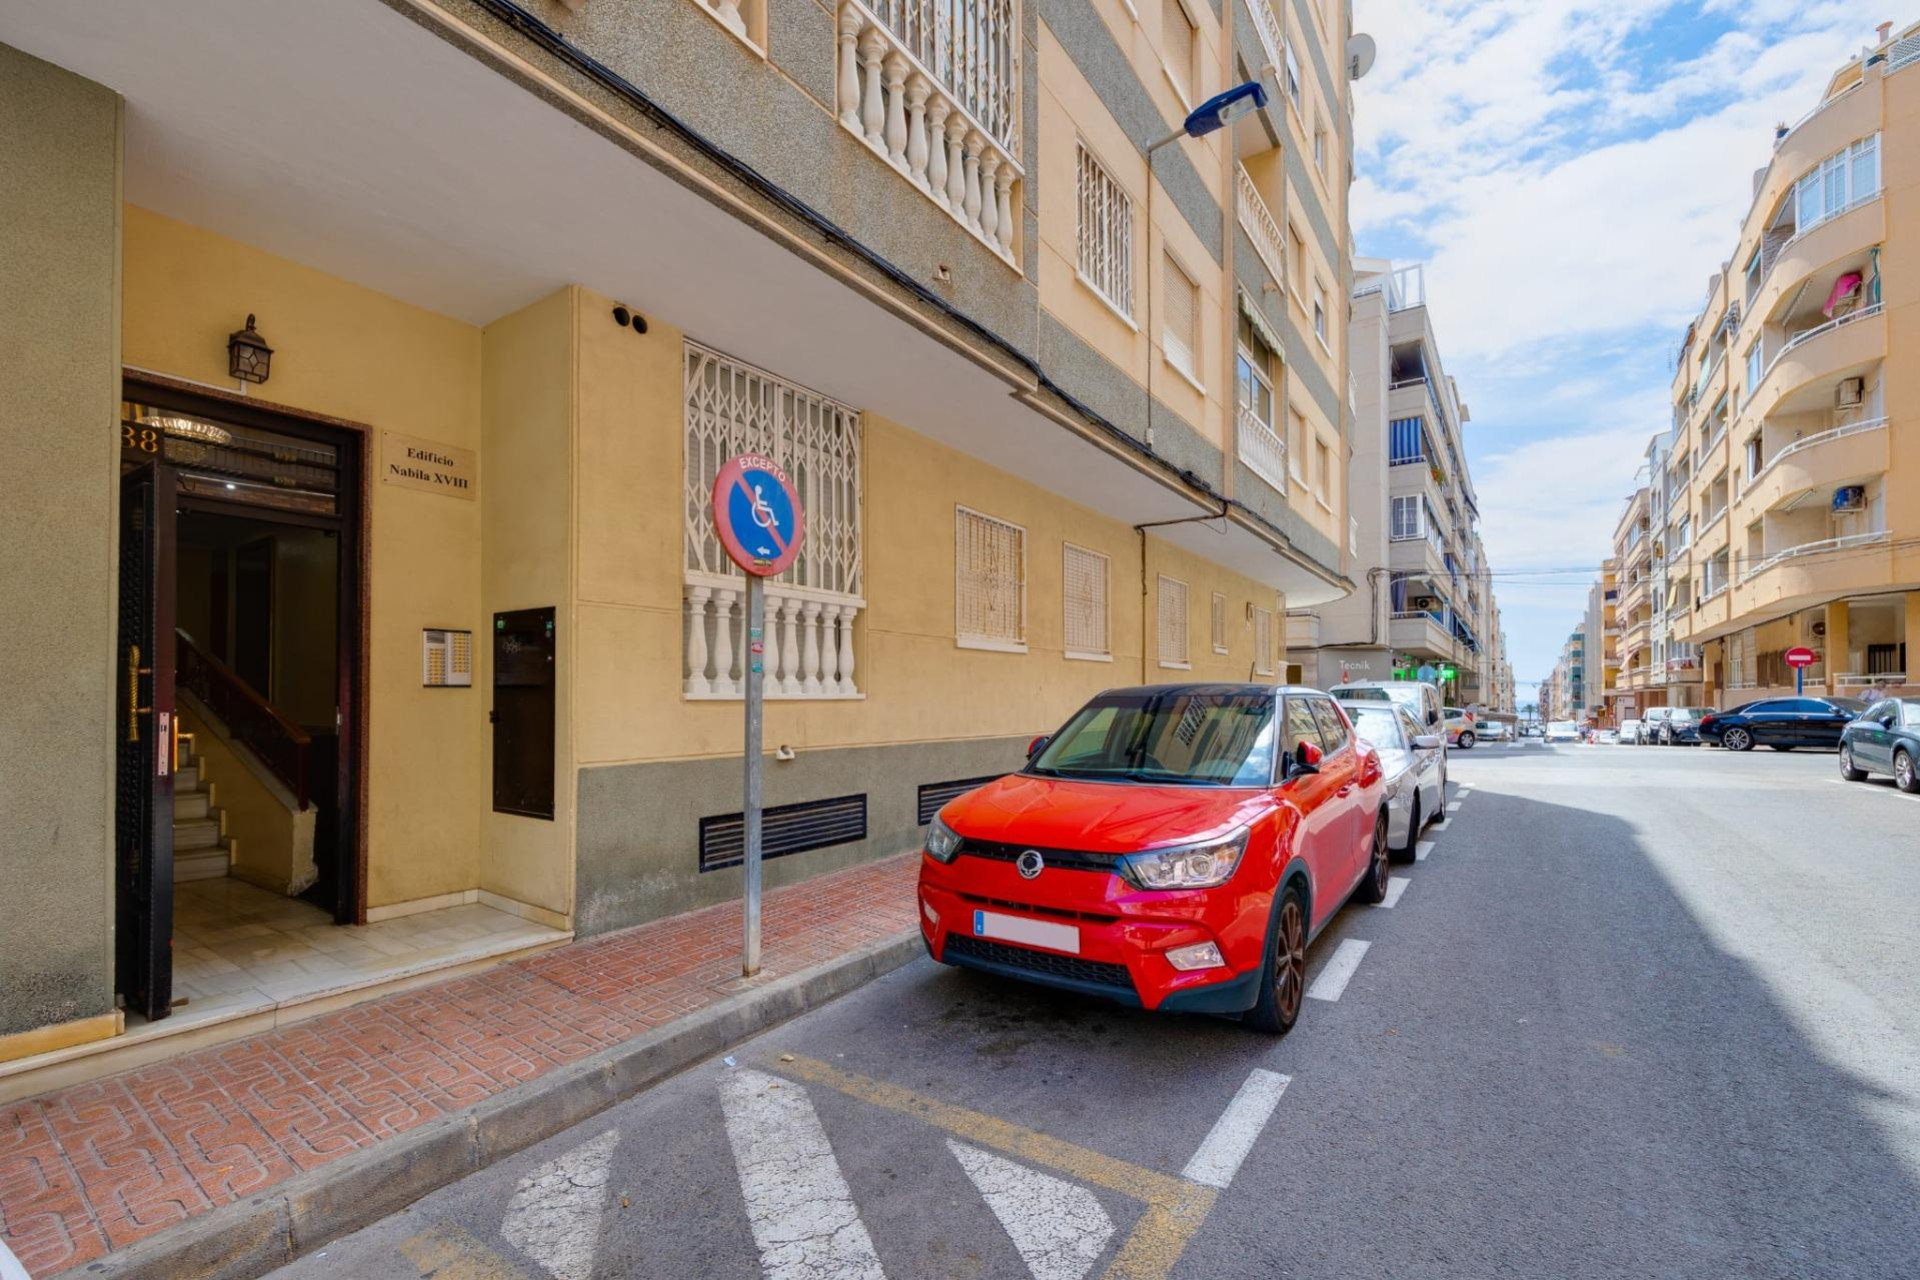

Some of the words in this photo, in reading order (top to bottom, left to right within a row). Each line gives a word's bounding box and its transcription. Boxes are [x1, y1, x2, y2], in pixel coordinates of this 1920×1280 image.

[407, 448, 454, 467] Edificio
[390, 464, 430, 481] Nabila
[739, 457, 785, 481] EXCEPTO
[1340, 660, 1370, 671] Tecnik
